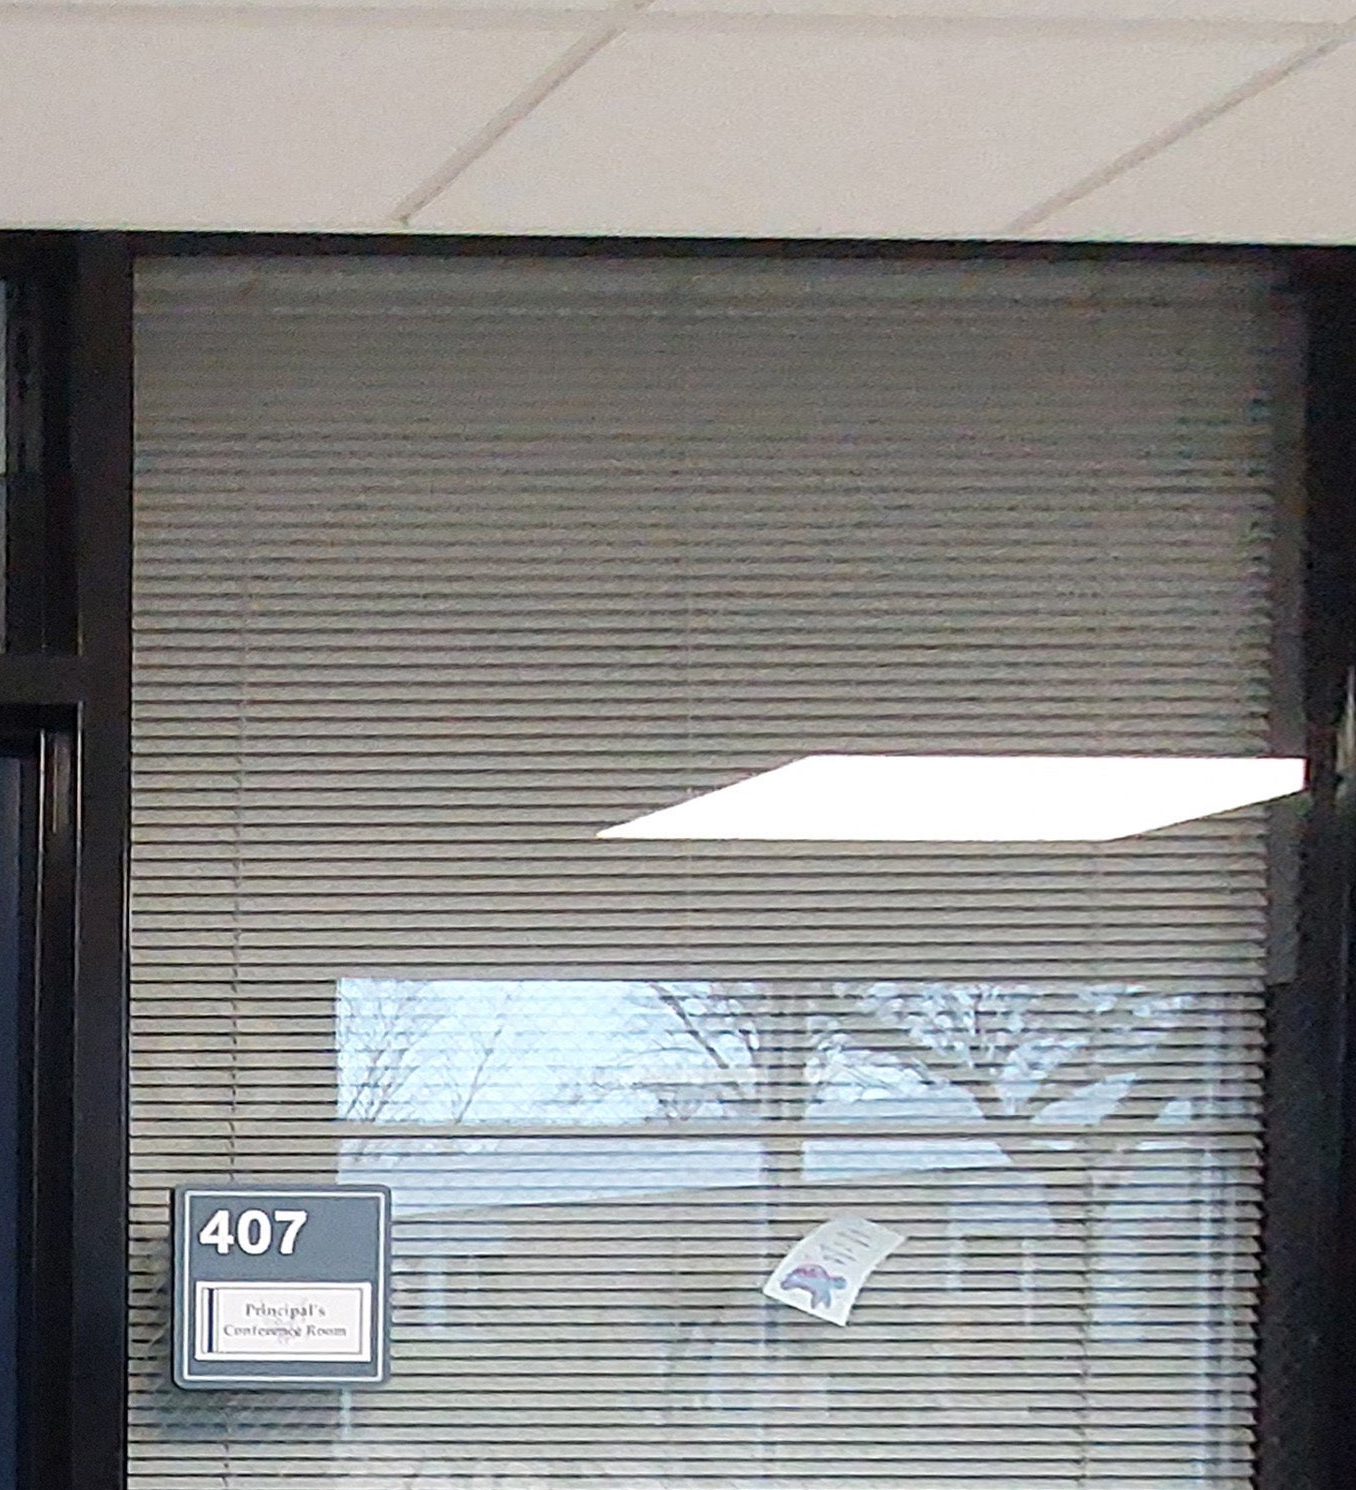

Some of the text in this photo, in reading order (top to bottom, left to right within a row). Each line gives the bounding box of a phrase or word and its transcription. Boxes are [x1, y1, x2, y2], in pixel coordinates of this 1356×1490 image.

[199, 1209, 308, 1255] 407
[245, 1303, 326, 1320] Principal's
[306, 1324, 347, 1337] Room
